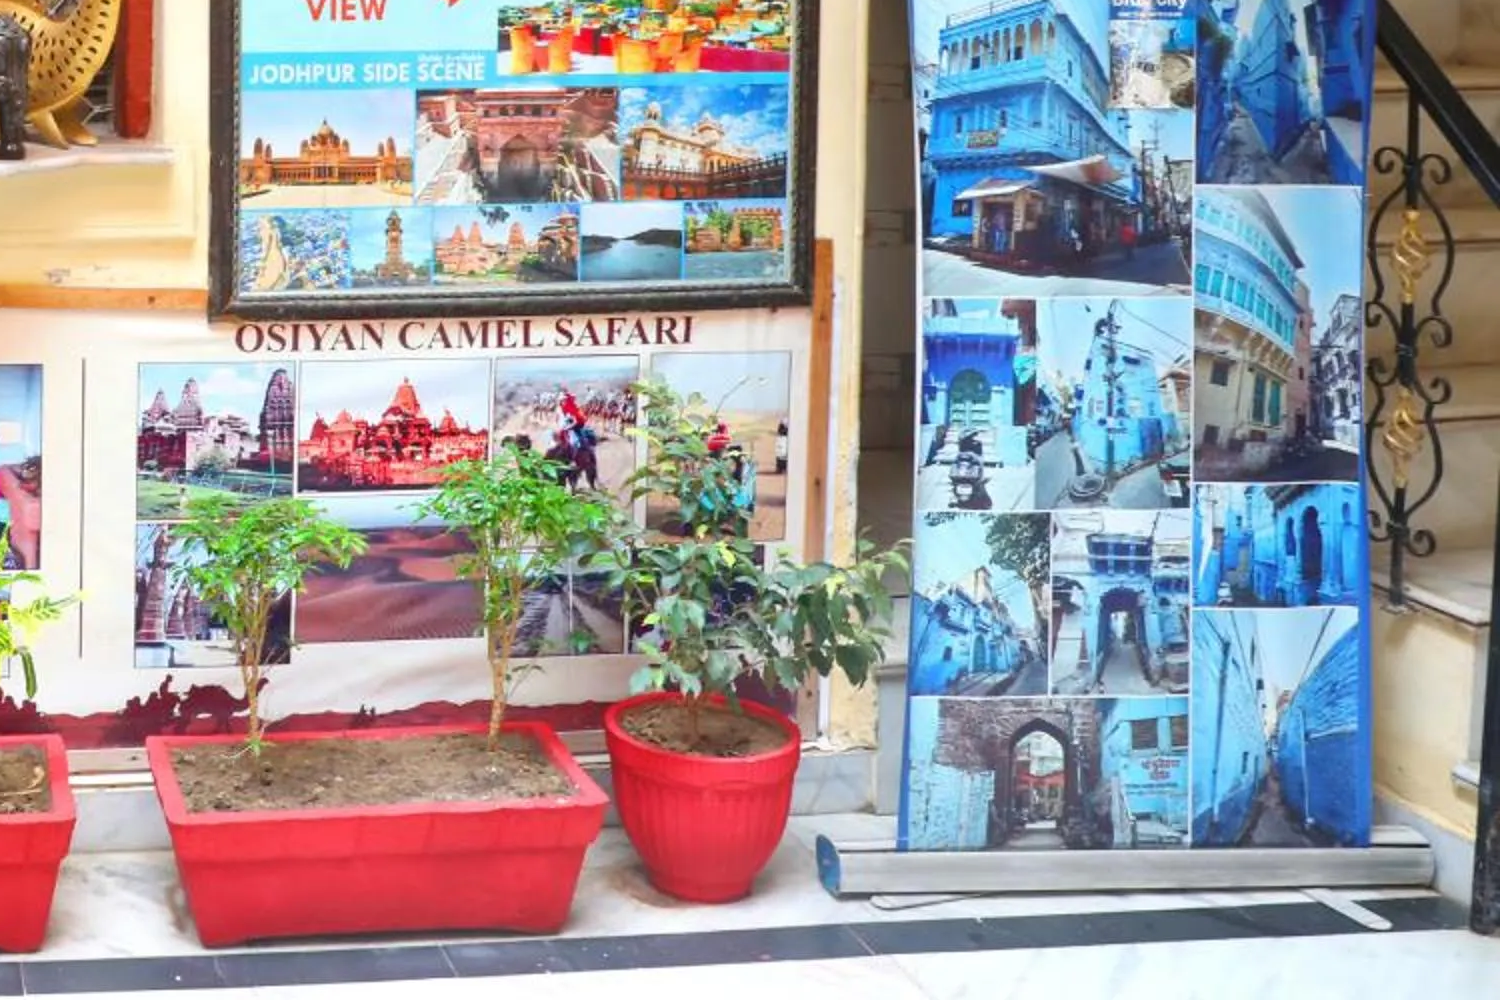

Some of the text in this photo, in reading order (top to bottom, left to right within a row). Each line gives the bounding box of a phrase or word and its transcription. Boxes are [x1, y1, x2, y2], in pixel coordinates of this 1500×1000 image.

[249, 62, 486, 84] JODHPUR SIDE SCENE
[234, 315, 695, 353] OSIYAN CAMEL SAFARI
